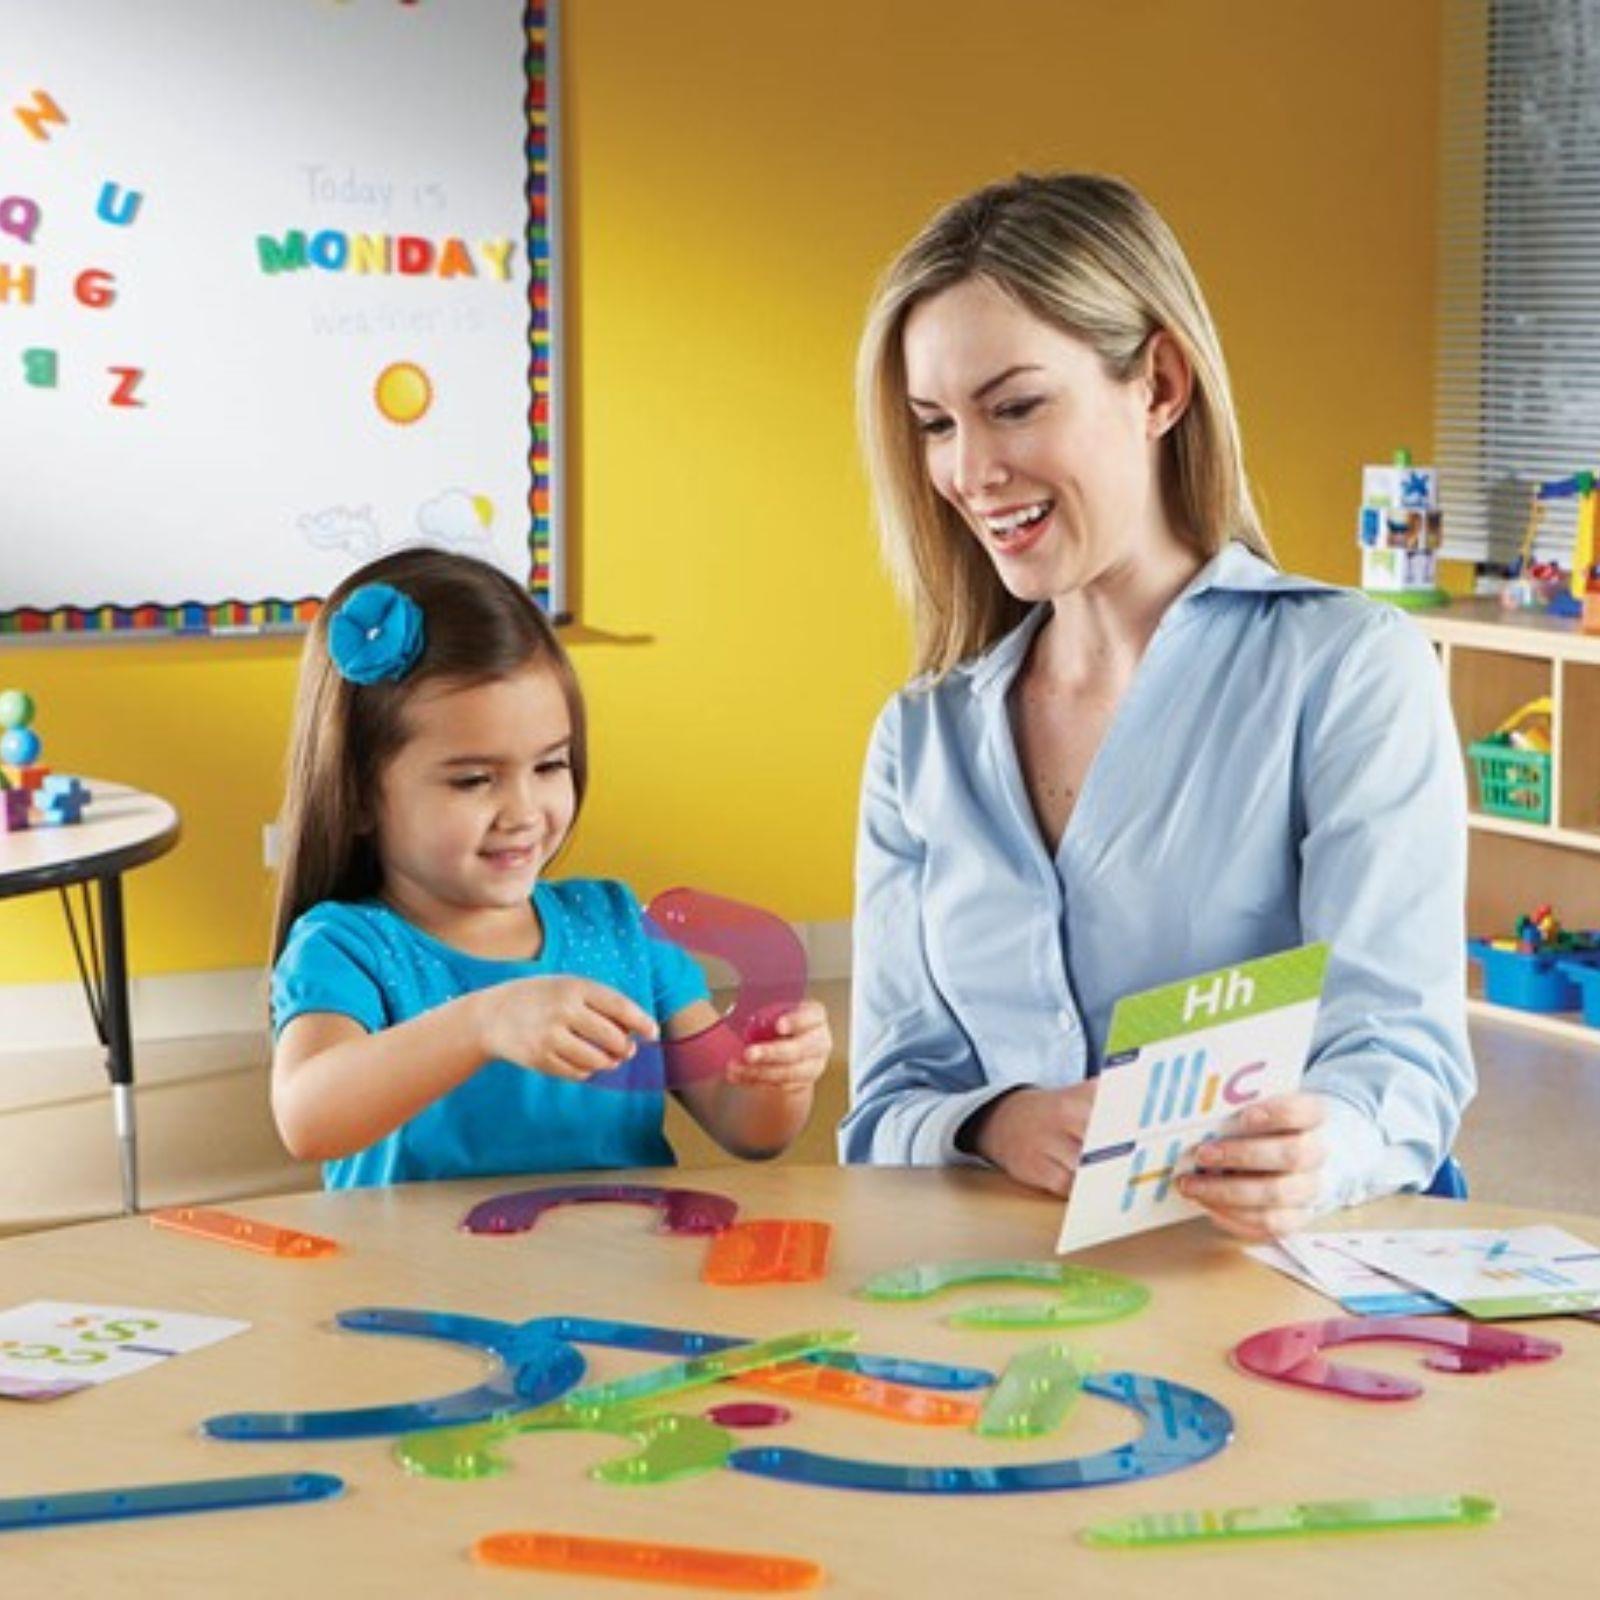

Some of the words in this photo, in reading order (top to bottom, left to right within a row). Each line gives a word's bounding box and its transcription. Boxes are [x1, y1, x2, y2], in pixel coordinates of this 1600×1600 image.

[97, 181, 142, 226] U
[300, 164, 393, 215] Today
[0, 195, 41, 244] Q
[257, 230, 516, 281] MONDAY
[0, 264, 36, 304] H
[74, 268, 117, 309] G
[107, 366, 148, 407] Z
[1182, 969, 1255, 1022] Hh
